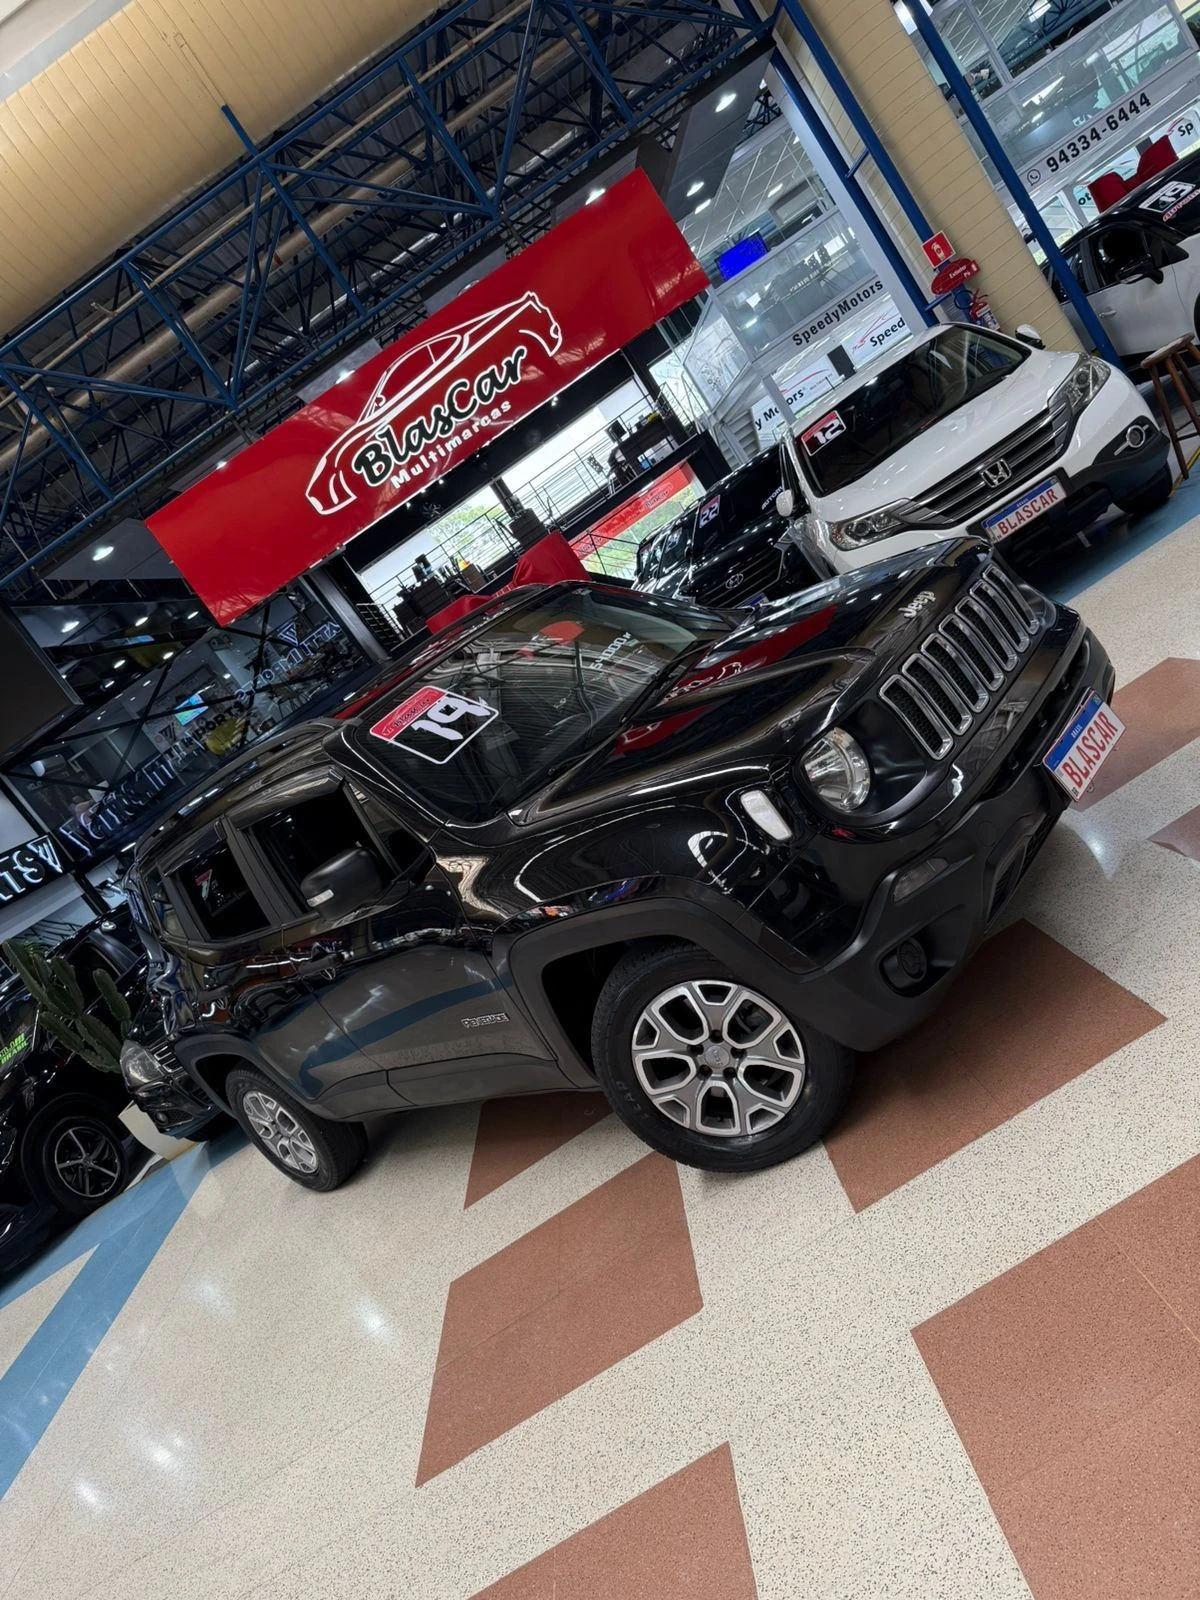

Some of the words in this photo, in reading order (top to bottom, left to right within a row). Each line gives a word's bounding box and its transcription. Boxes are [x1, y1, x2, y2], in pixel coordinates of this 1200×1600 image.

[1046, 92, 1151, 172] 94334-6444
[792, 280, 884, 346] SpeedyMotors
[870, 317, 905, 347] Speed
[352, 345, 527, 486] BlasCar
[814, 418, 841, 444] 12
[390, 400, 511, 488] Multimarcas
[997, 489, 1058, 535] BLASCAR
[898, 590, 936, 618] Jeep
[410, 696, 491, 741] 19
[1062, 711, 1118, 788] BLASCAR
